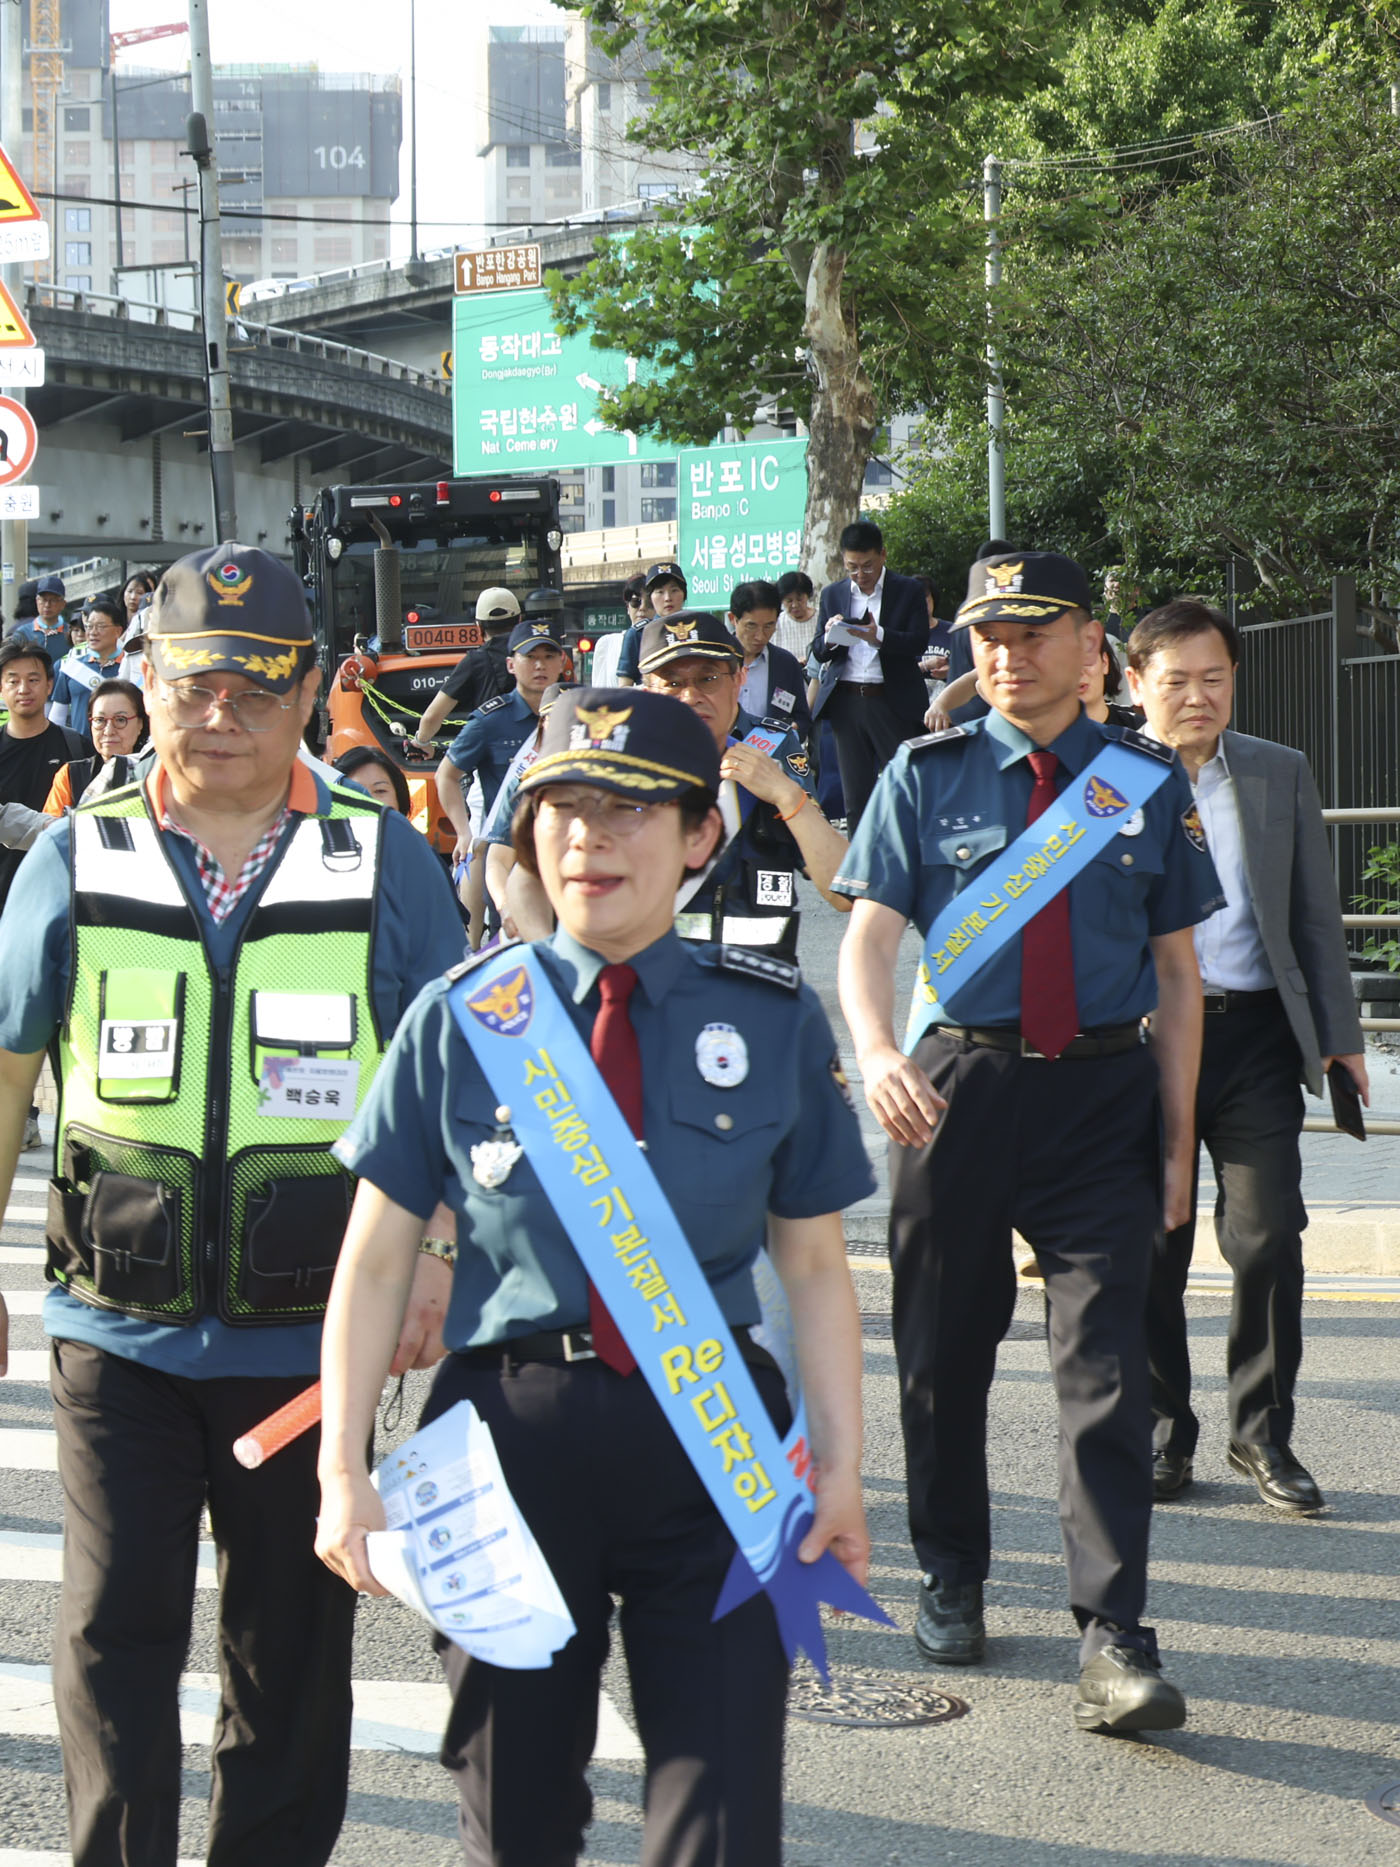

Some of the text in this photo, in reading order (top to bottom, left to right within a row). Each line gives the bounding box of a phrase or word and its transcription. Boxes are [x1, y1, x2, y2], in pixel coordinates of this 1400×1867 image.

[314, 145, 366, 169] 104
[475, 247, 537, 273] 반포한강공원
[476, 269, 537, 288] Banpo Hangang Park
[506, 437, 558, 453] Cemeery
[691, 501, 730, 520] Banpo
[691, 530, 802, 571] 서울성모병원
[692, 575, 719, 594] Seoul
[747, 734, 777, 754] NO!
[931, 821, 1086, 974] 시민중심 기본질서
[286, 1088, 341, 1107] 백승욱
[522, 1047, 613, 1186] 시민중심
[589, 1187, 688, 1335] 기본질서
